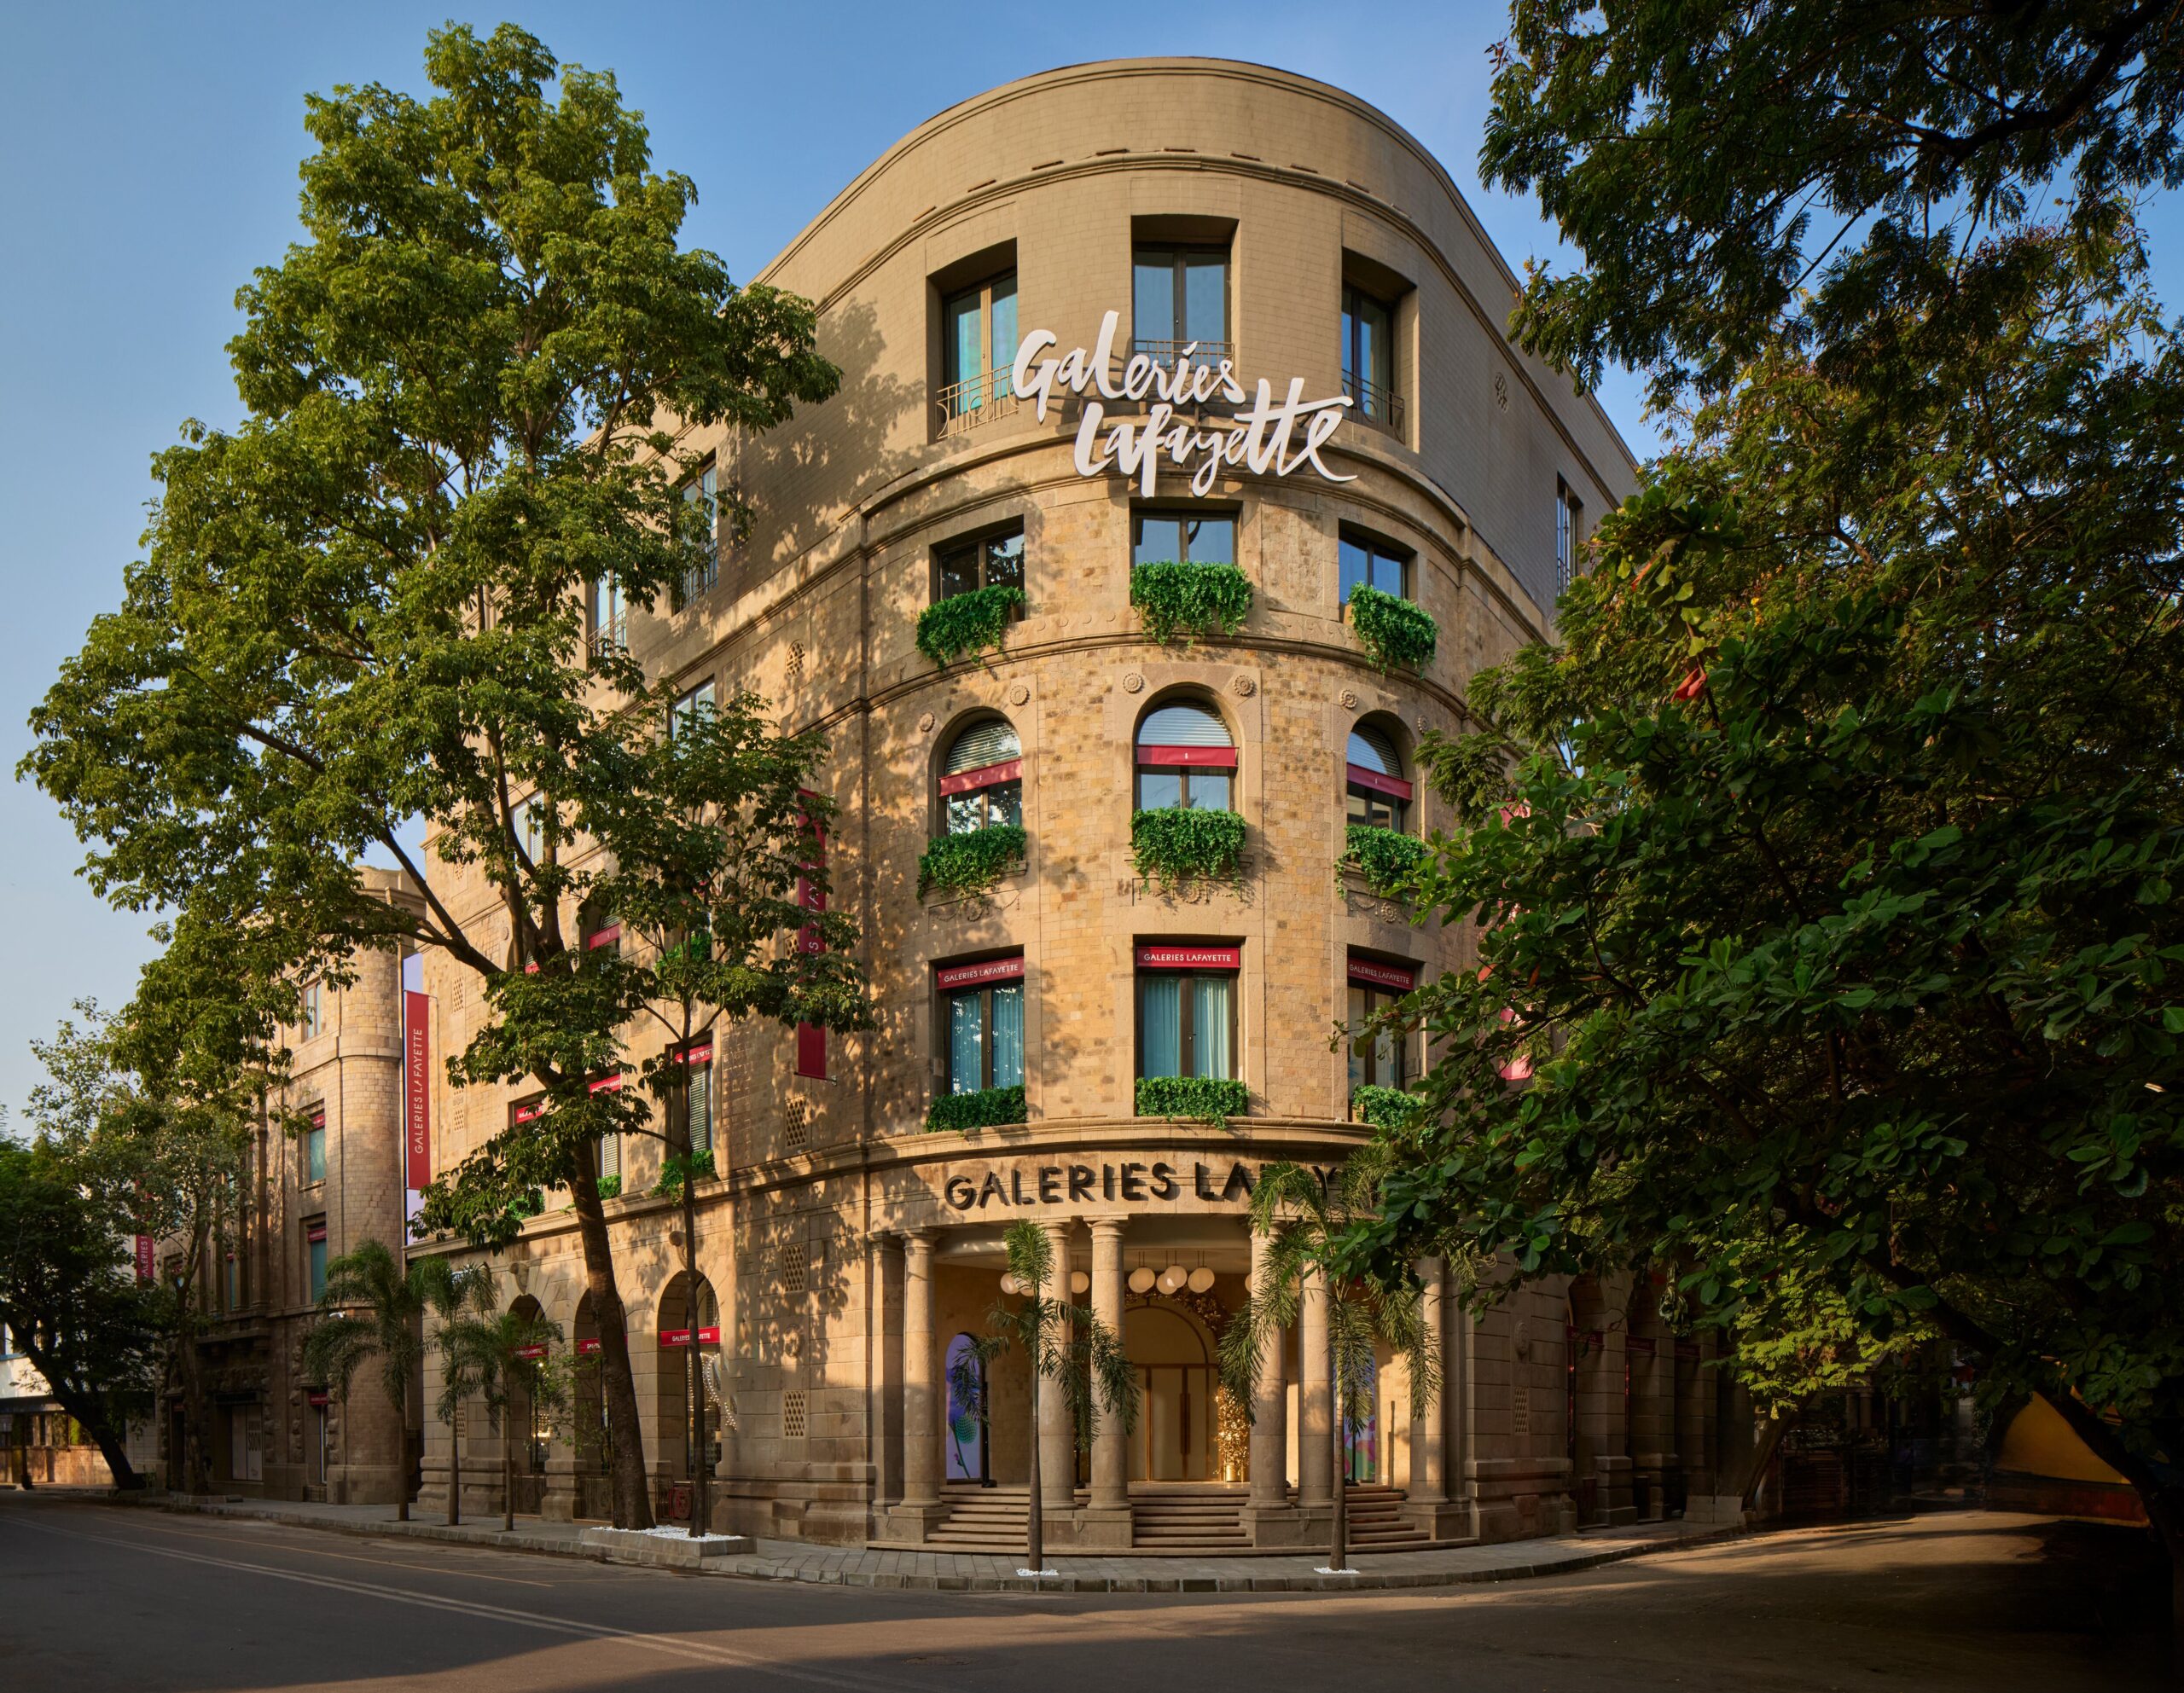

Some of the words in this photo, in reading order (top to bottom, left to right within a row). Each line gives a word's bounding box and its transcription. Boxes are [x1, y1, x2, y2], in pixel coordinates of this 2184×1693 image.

[1074, 377, 1358, 499] Lafayette
[944, 971, 978, 983] GALERIES
[979, 964, 1019, 977] LAFAYETTE
[1143, 954, 1185, 962] GALERIES
[1349, 964, 1378, 977] GALERIES
[1378, 971, 1410, 984] LAFAYETTE
[414, 1097, 424, 1154] GALERIES
[944, 1162, 1173, 1210] GALERIES
